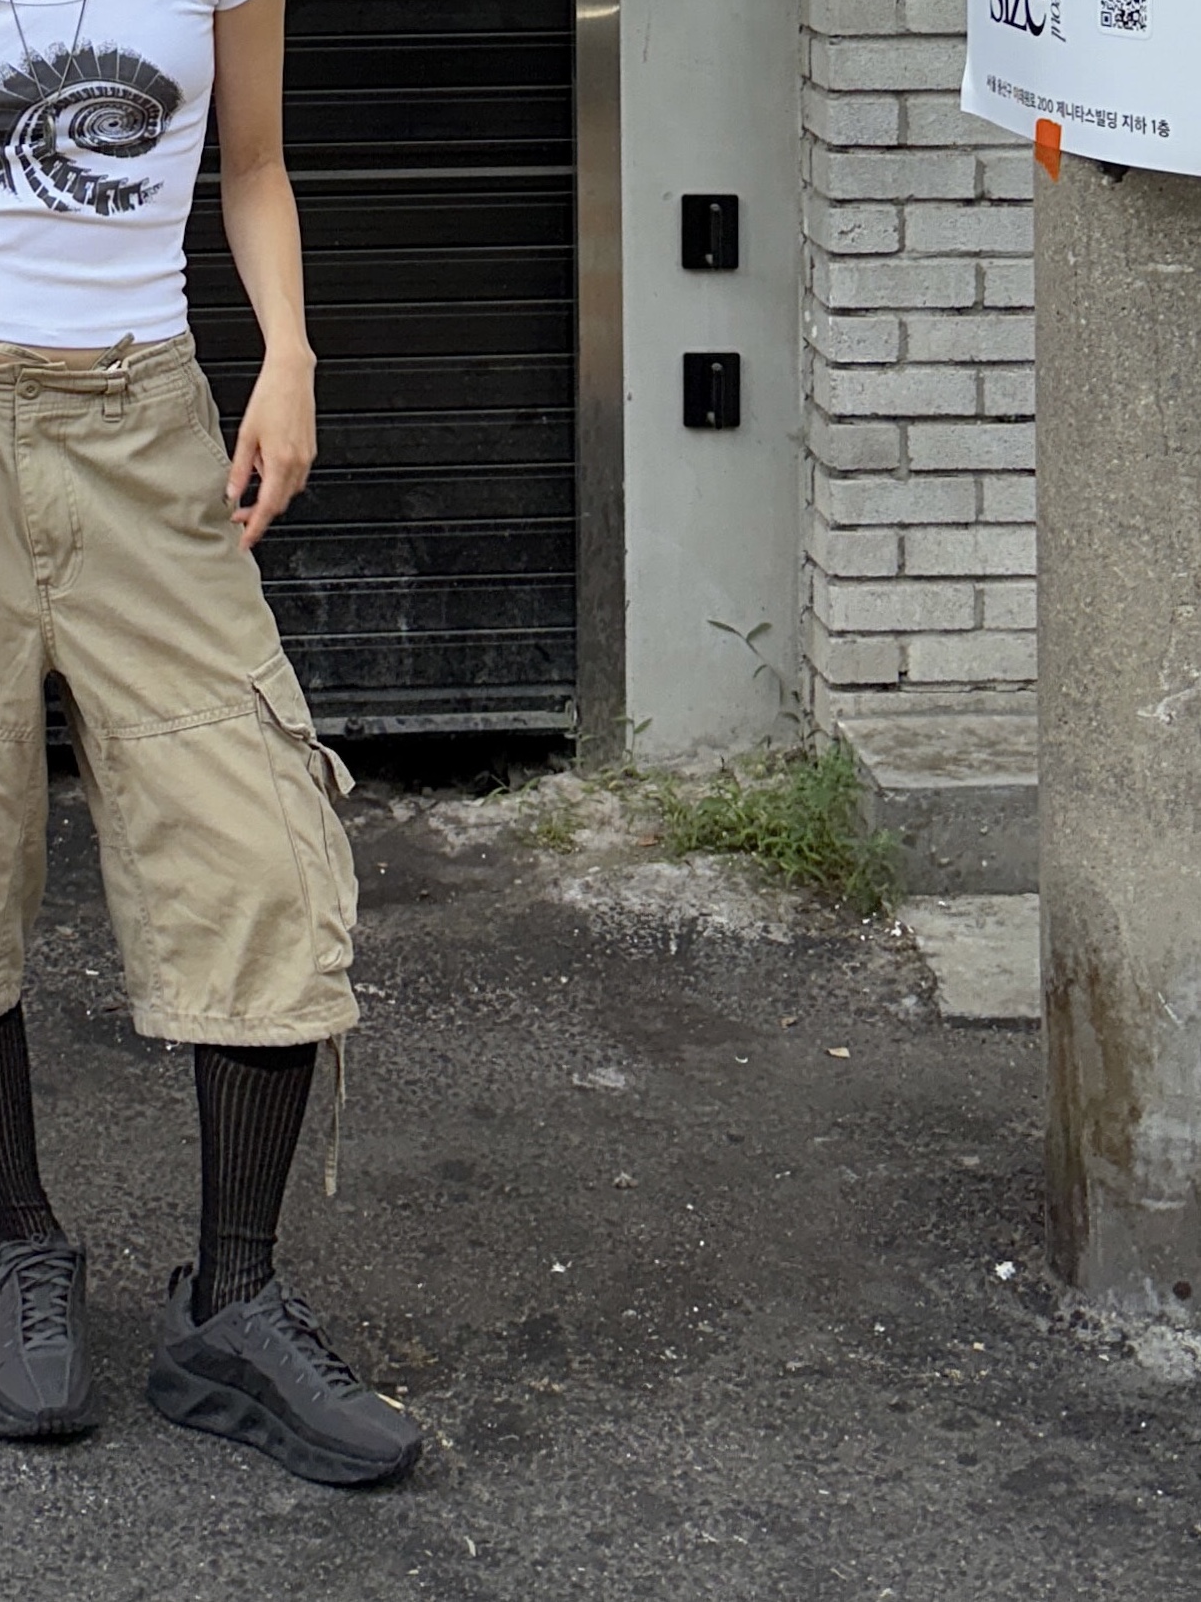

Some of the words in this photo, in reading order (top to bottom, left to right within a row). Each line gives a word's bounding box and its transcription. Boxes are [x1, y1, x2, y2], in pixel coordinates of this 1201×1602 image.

[1037, 95, 1054, 113] 200
[1121, 114, 1147, 135] 지하
[1151, 119, 1171, 139] 1층
